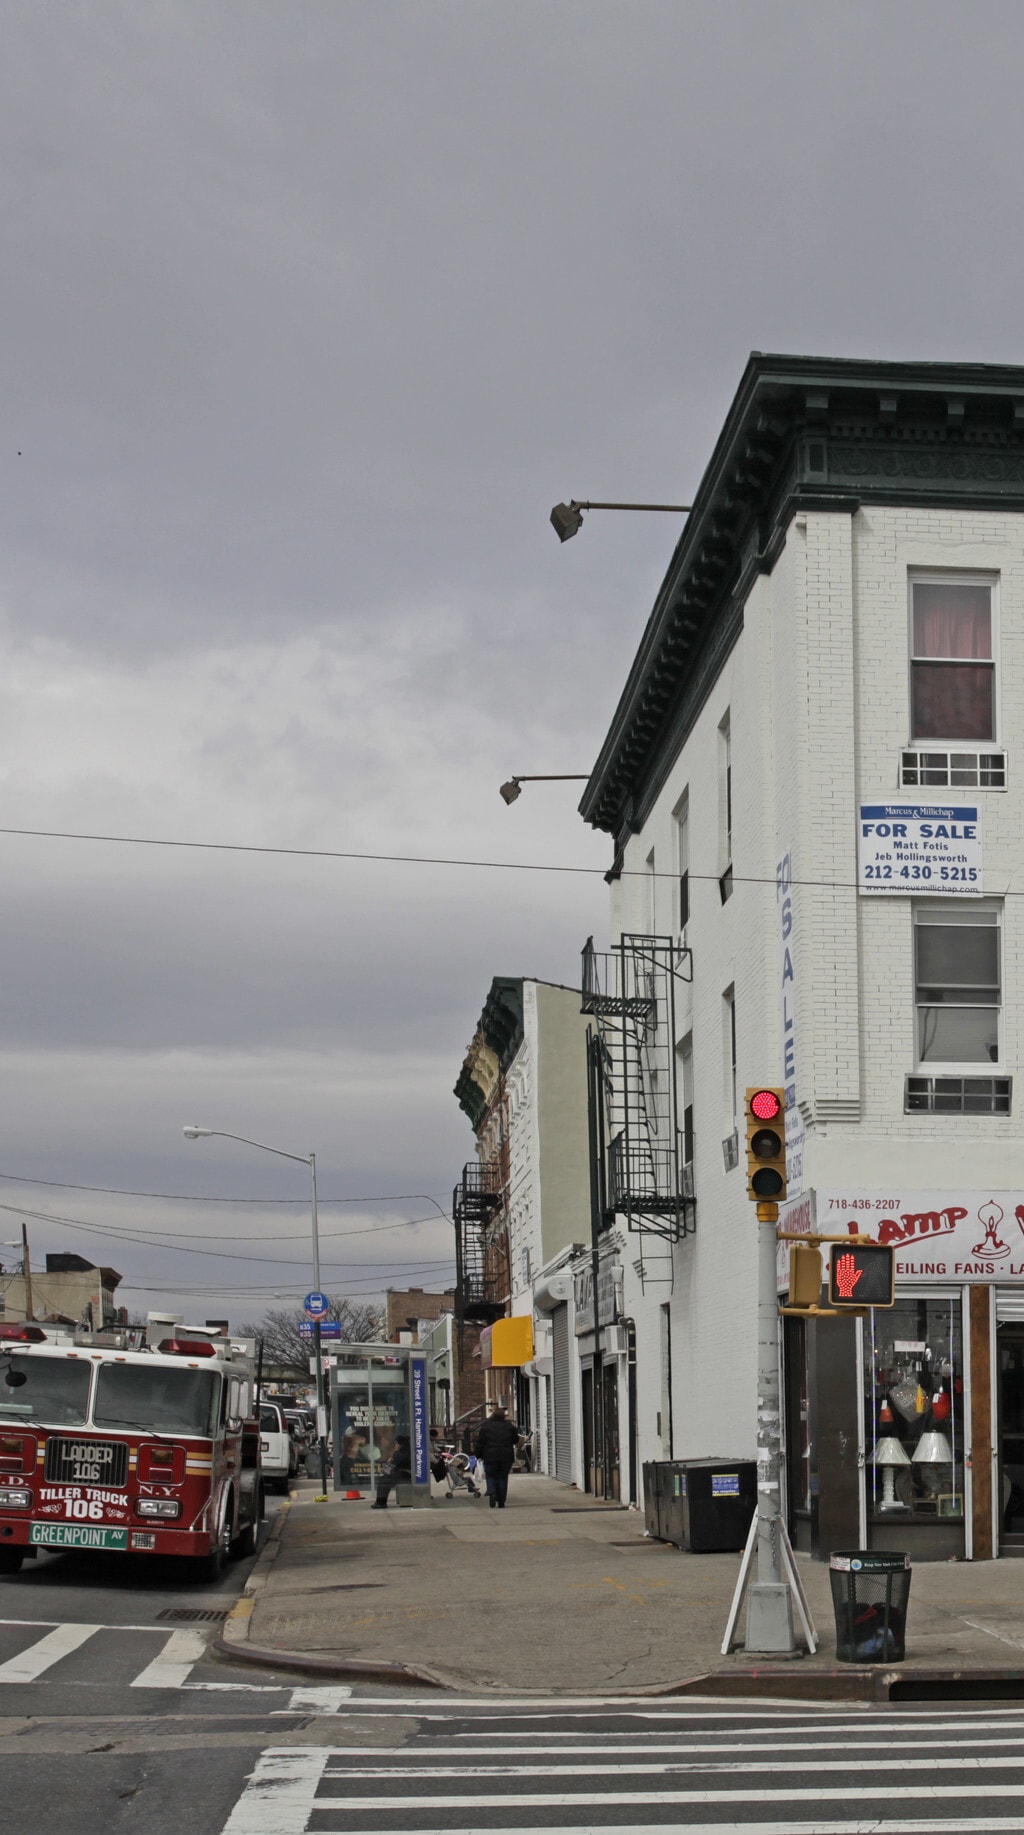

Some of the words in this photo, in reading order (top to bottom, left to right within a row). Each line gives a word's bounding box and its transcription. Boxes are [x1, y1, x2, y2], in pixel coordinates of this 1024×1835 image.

[885, 807, 912, 815] Marcus
[912, 810, 920, 819] &
[920, 808, 954, 819] Millichap
[862, 824, 908, 838] FOR
[920, 824, 976, 839] SALE
[894, 841, 918, 850] Matt
[923, 842, 948, 850] Fotis
[875, 852, 892, 860] Jeb
[896, 853, 968, 863] Hollingsworth
[864, 865, 978, 881] 212-430-5215
[828, 1200, 900, 1210] 718-436-2207
[896, 1262, 946, 1274] EILING
[954, 1262, 994, 1274] FANS
[414, 1370, 421, 1378] 39
[62, 1444, 113, 1464] LADDER
[73, 1463, 100, 1480] 106
[0, 1475, 29, 1486] .D.
[40, 1488, 81, 1500] TILLER
[86, 1488, 128, 1506] TRUCK
[139, 1486, 180, 1497] N.Y.
[64, 1499, 104, 1519] 106
[32, 1525, 108, 1546] GREENPOINT
[111, 1532, 124, 1540] AV
